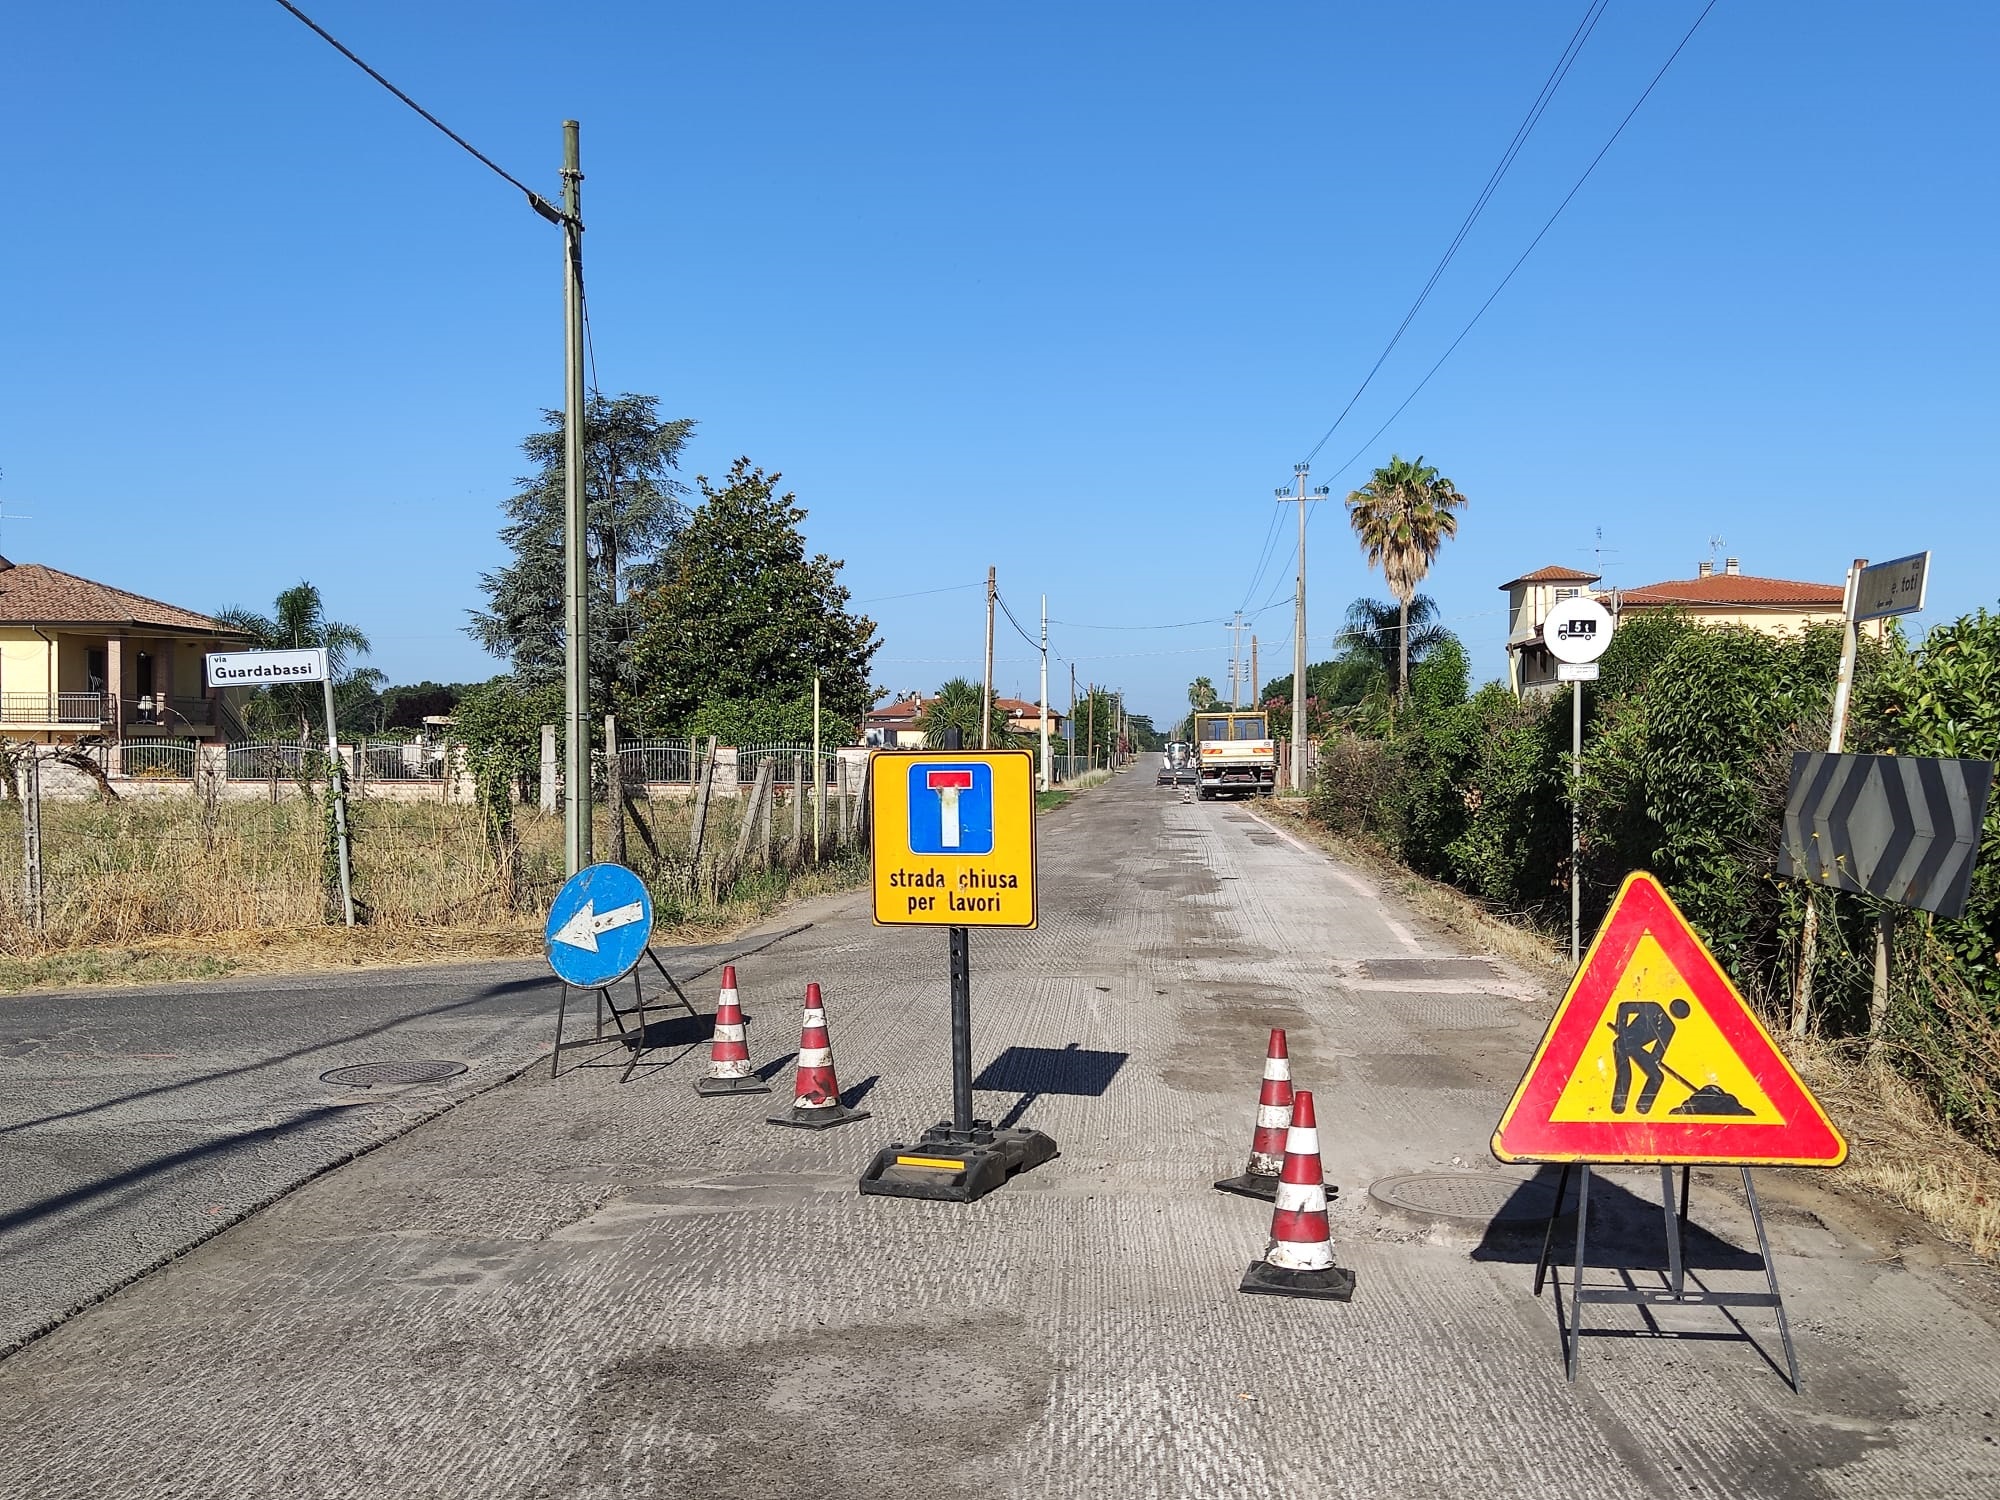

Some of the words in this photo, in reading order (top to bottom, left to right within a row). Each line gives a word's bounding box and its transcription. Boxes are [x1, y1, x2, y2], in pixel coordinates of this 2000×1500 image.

[1574, 621, 1582, 633] 5
[215, 663, 312, 679] Guardabassi
[890, 868, 945, 888] strada
[959, 868, 1018, 889] chiusa
[908, 896, 935, 915] per
[949, 891, 1000, 912] lavori
